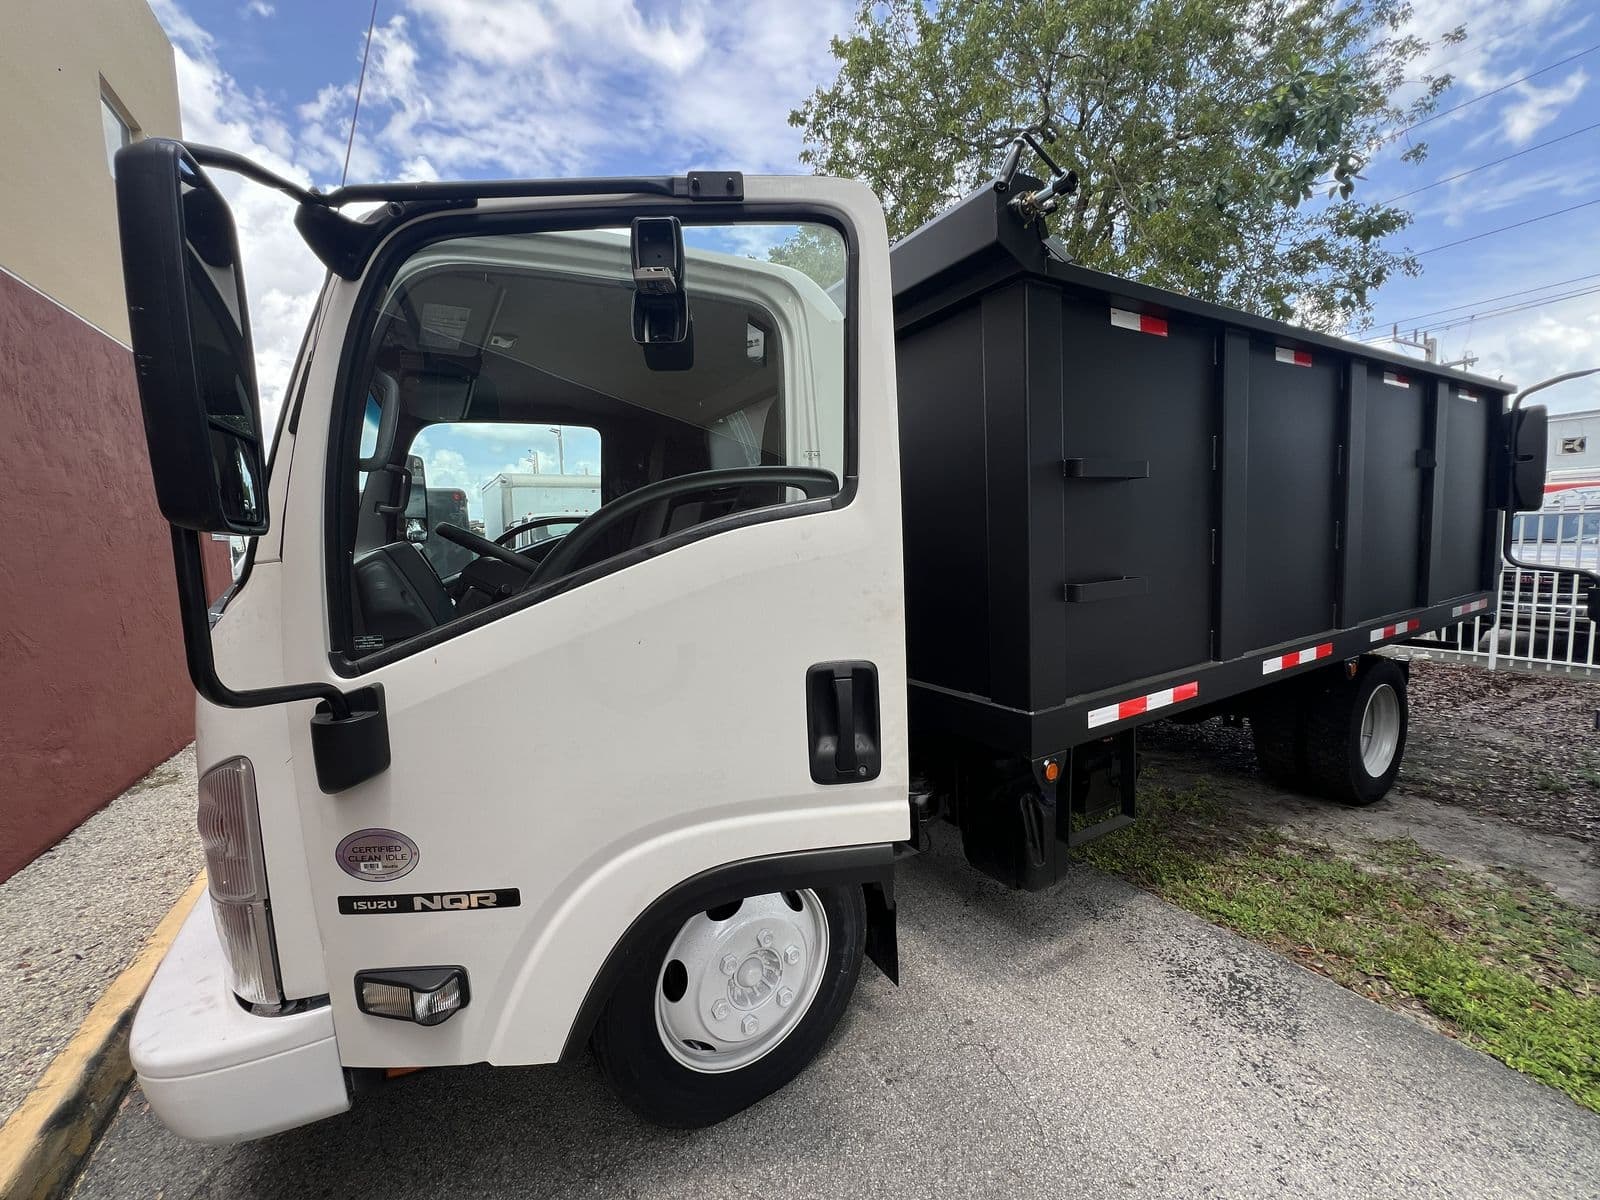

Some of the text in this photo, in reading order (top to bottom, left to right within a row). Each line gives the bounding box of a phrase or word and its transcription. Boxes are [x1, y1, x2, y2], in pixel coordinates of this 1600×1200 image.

[352, 846, 402, 854] CERTIFIED
[348, 853, 408, 863] CLEAN IDLE
[353, 892, 497, 911] ISUZU NQR
